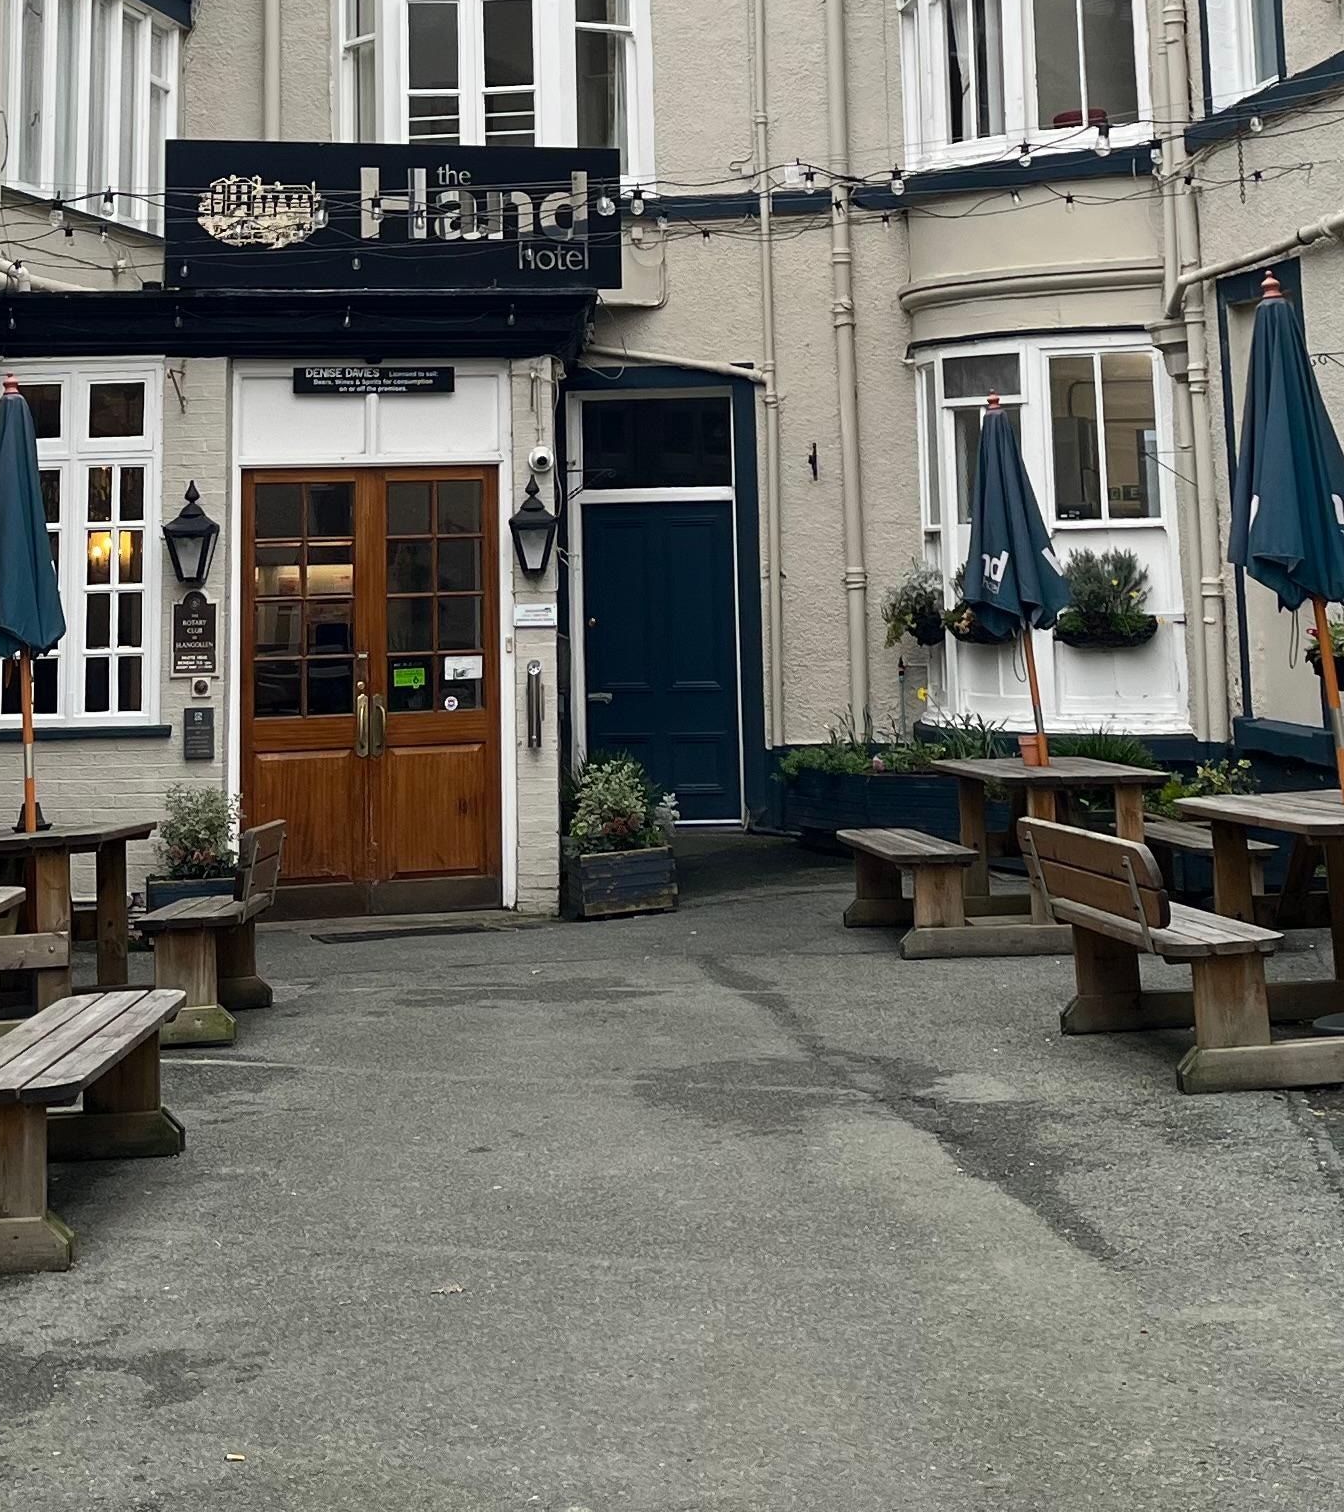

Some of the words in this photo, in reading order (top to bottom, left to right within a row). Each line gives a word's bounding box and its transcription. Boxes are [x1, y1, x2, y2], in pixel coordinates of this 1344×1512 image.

[436, 164, 472, 186] the
[360, 167, 588, 241] Hand
[518, 240, 589, 270] hotel
[305, 368, 343, 378] DENISE
[345, 368, 380, 378] DAVIES
